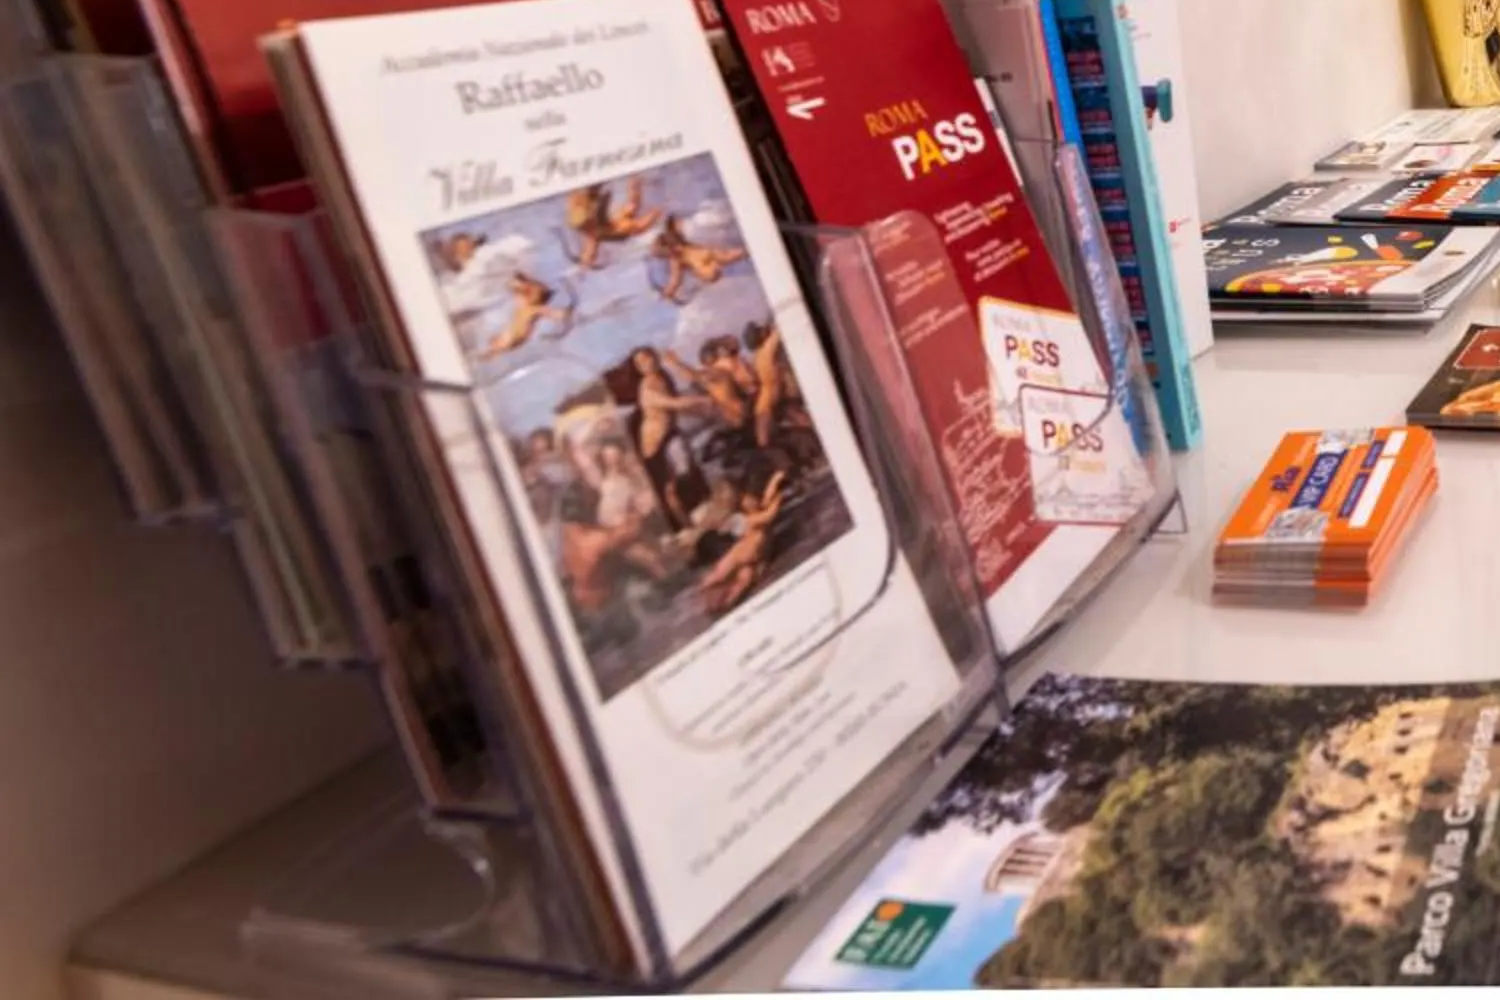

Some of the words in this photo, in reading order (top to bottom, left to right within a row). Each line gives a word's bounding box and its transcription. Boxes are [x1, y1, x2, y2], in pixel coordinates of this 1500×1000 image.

[745, 1, 817, 35] ROMA
[454, 62, 605, 115] Raffaello
[864, 99, 928, 136] ROMA
[891, 112, 985, 181] PASS
[1005, 335, 1061, 368] PASS
[1042, 420, 1103, 452] PASS
[1425, 828, 1470, 888] Villa
[1399, 891, 1455, 976] Parco
